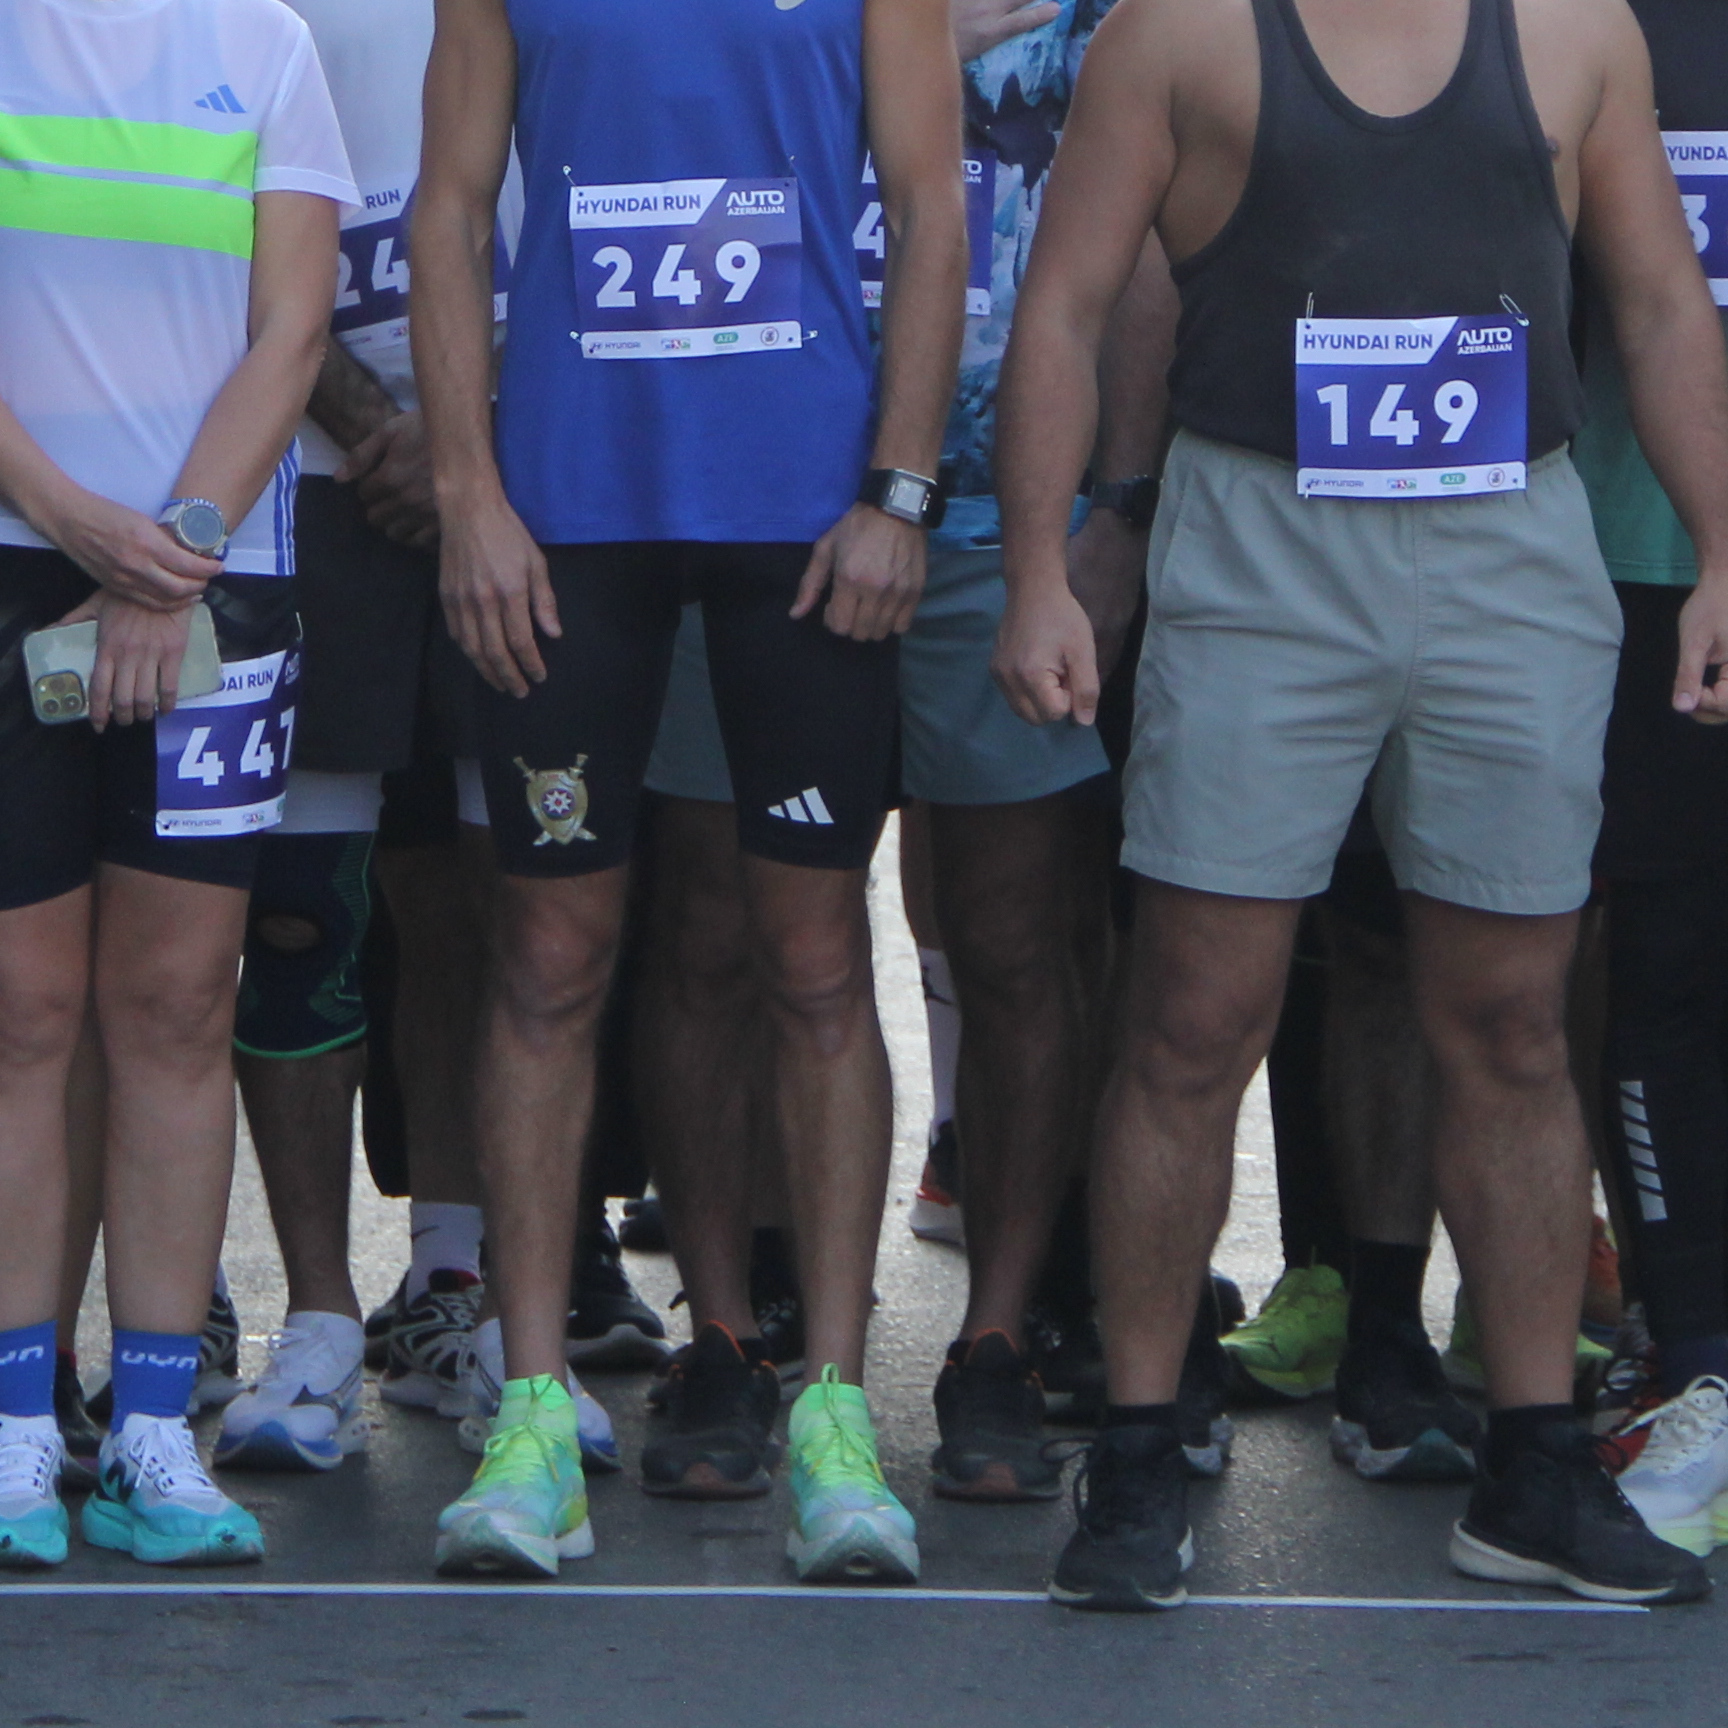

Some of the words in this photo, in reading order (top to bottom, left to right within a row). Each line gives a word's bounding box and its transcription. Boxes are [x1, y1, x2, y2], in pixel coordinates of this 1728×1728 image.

[365, 189, 402, 210] RUN
[576, 195, 658, 215] HYUNDAI
[663, 194, 701, 211] RUN
[726, 190, 785, 207] AUTO
[334, 237, 411, 310] 24
[592, 240, 761, 309] 249
[1303, 333, 1389, 350] HYUNDAI
[1395, 333, 1433, 350] RUN
[1456, 327, 1513, 346] AUTO
[1316, 379, 1479, 446] 149
[248, 669, 273, 686] RUN
